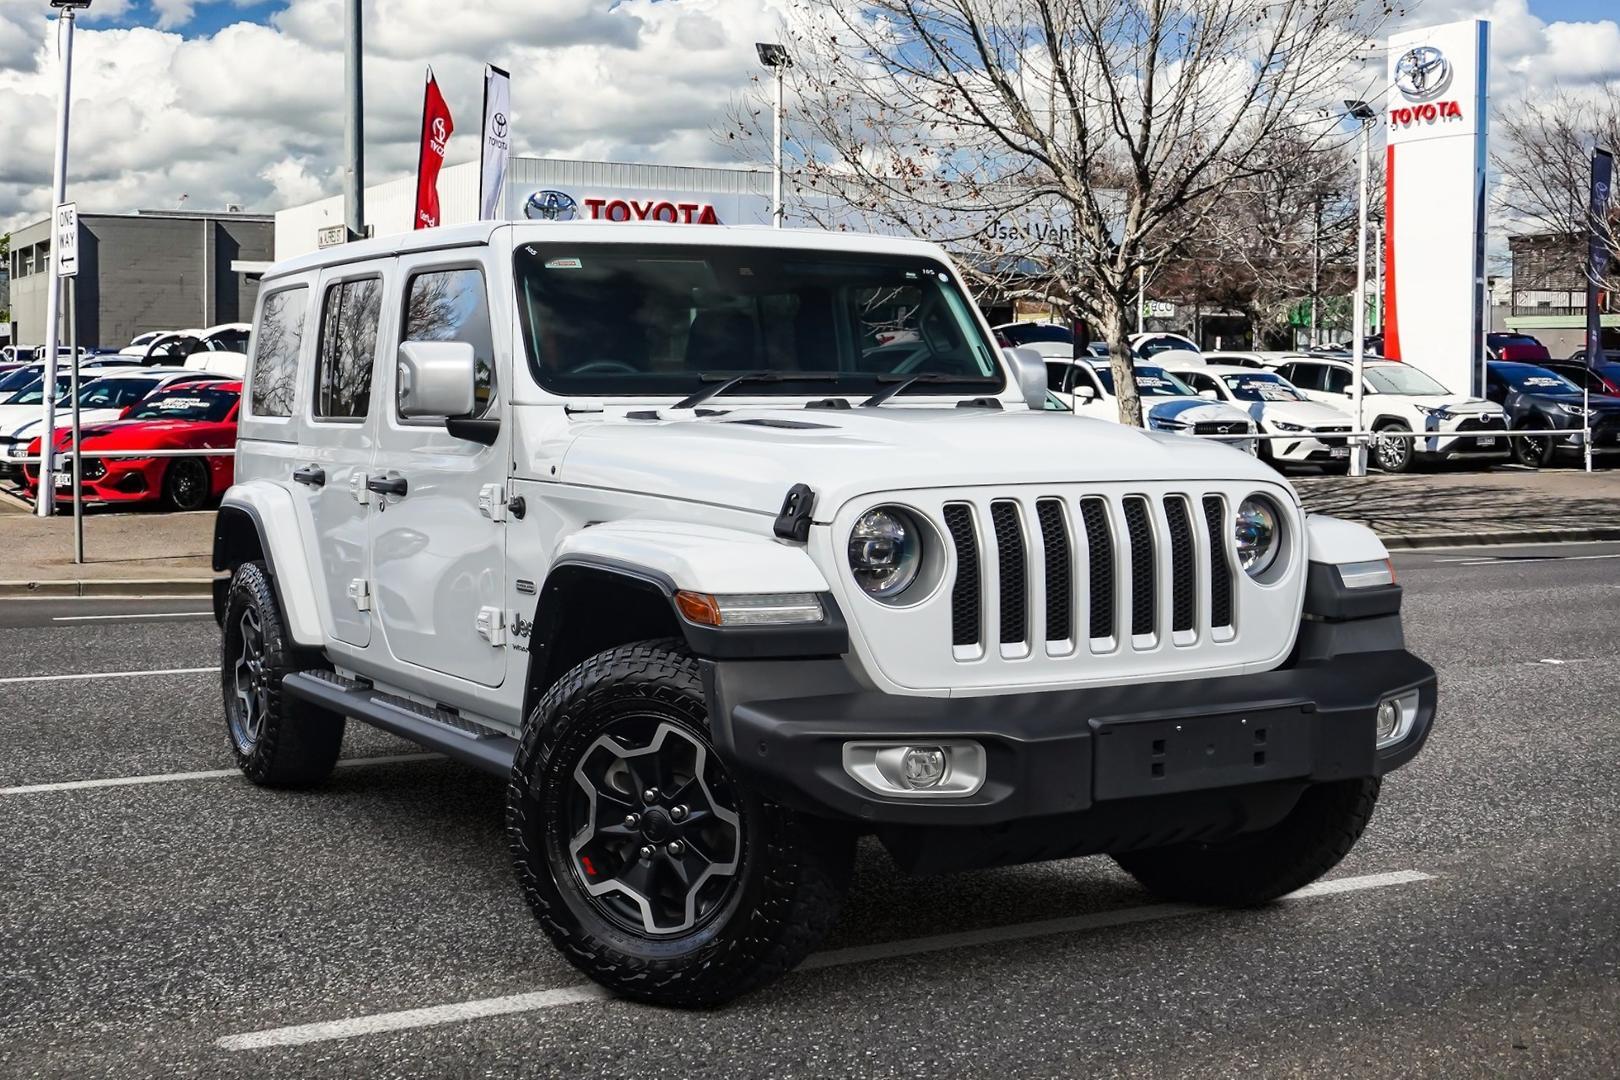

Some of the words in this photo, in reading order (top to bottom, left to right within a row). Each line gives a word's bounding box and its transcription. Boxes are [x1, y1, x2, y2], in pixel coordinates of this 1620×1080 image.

[1389, 100, 1463, 126] TOYOTA
[60, 209, 74, 228] ONE
[584, 198, 719, 225] TOYOTA
[59, 231, 75, 249] WAY
